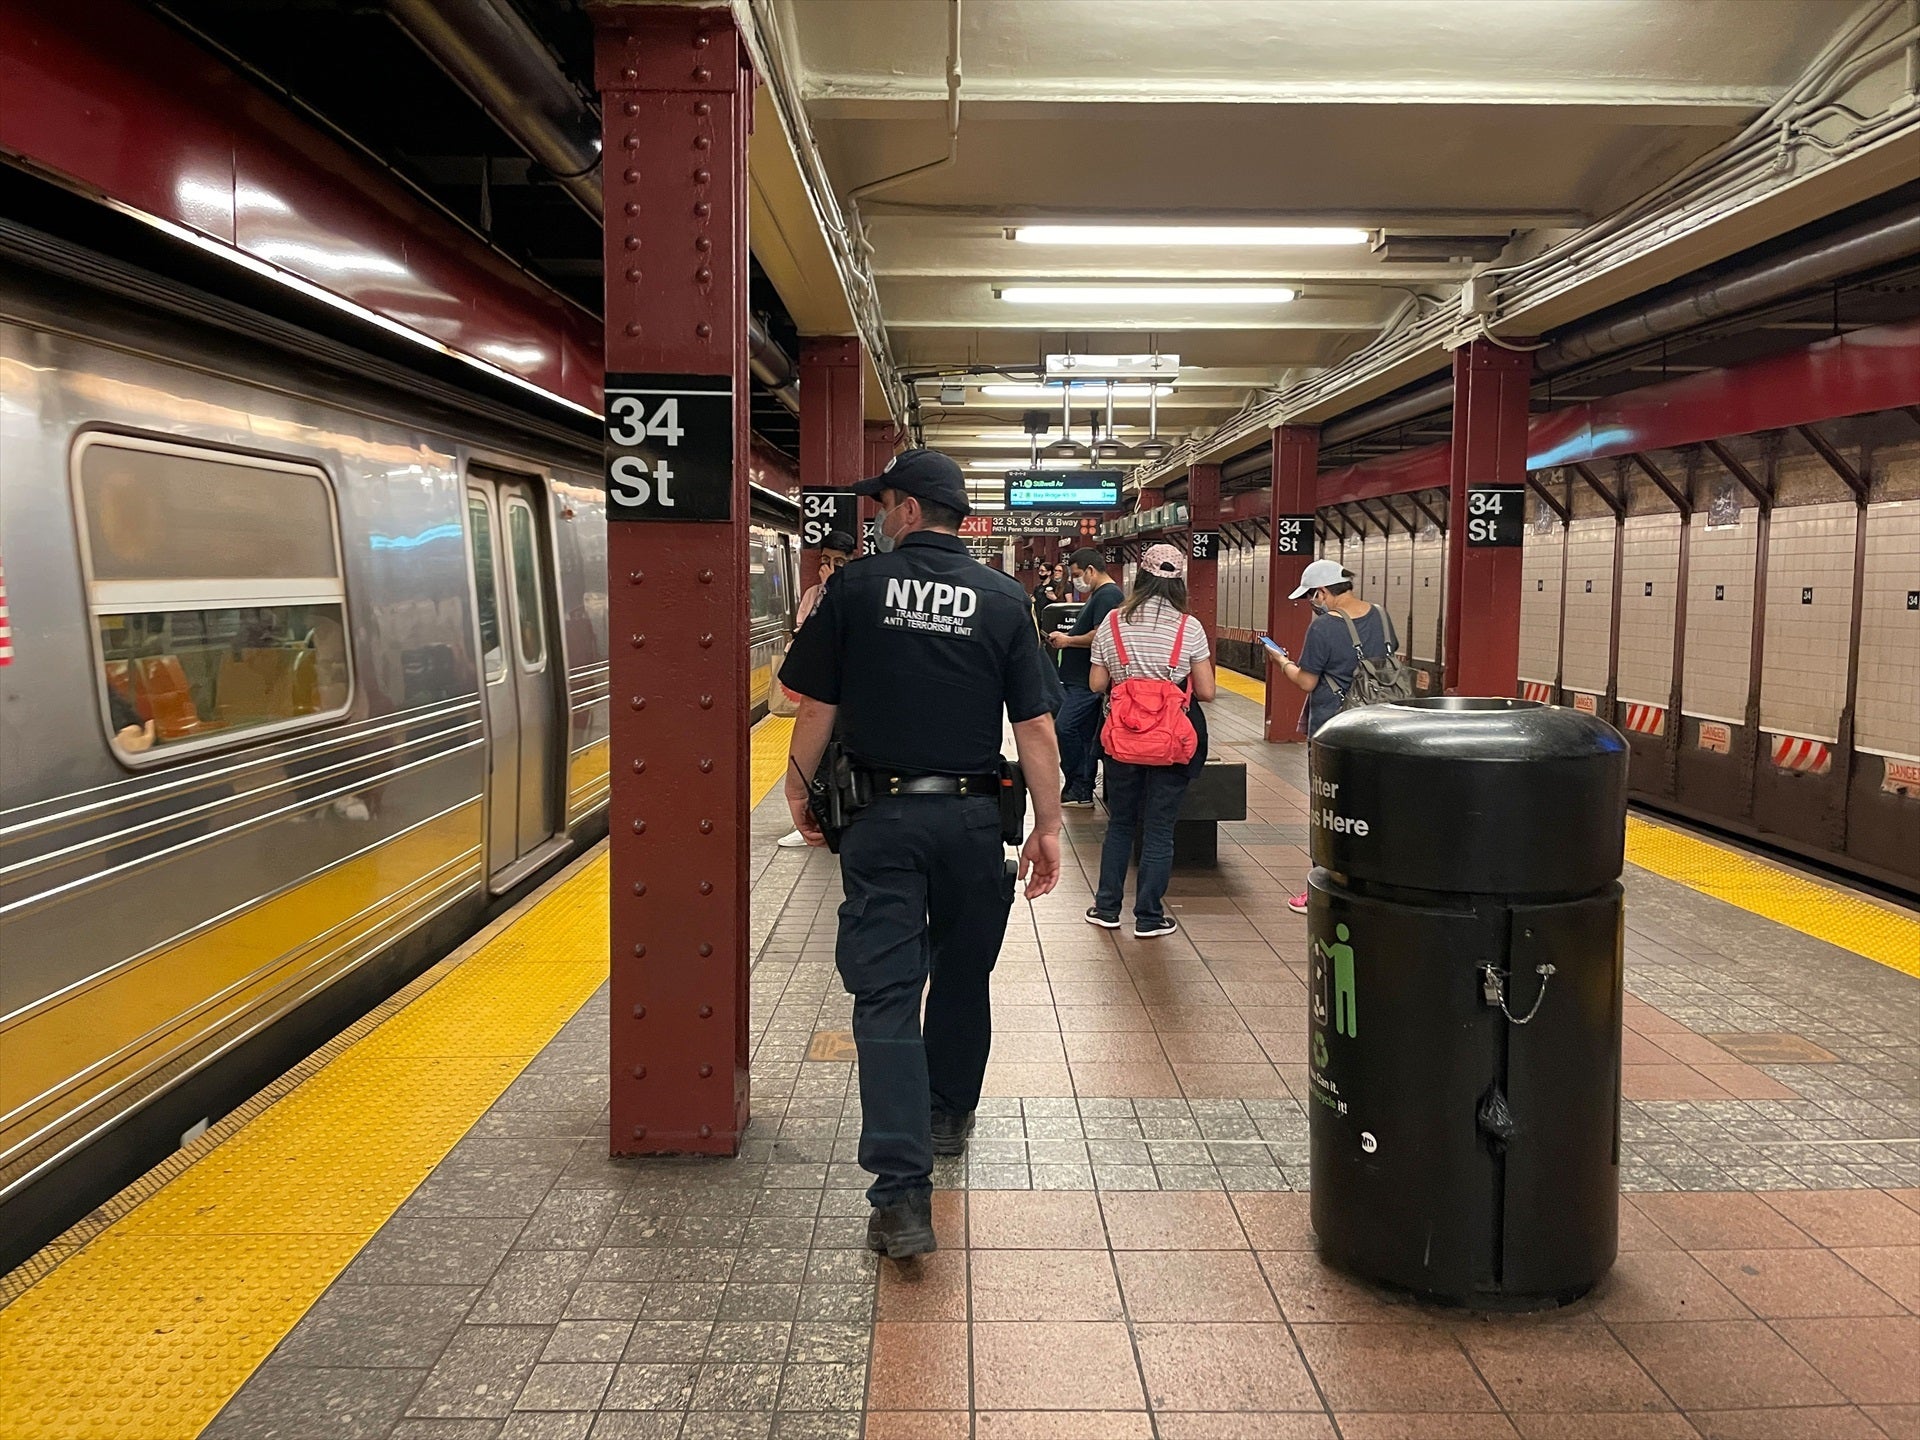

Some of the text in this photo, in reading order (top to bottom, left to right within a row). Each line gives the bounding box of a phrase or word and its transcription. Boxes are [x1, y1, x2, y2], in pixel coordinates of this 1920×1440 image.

[609, 396, 684, 447] 34
[610, 456, 675, 507] St
[804, 496, 837, 518] 34
[1470, 493, 1503, 515] 34
[1006, 518, 1017, 526] St,
[1056, 518, 1078, 527] Bway
[1280, 521, 1301, 535] 34
[1469, 519, 1498, 541] St
[804, 521, 832, 544] St
[1193, 534, 1209, 545] 34
[1193, 546, 1207, 557] St
[1279, 537, 1298, 552] St
[885, 578, 977, 618] NYPD
[1803, 590, 1811, 600] 34
[1908, 595, 1918, 605] 34
[883, 617, 973, 636] ANTI TERRORISM UNIT
[896, 609, 964, 626] TRANSIT BUREAU
[1702, 725, 1726, 739] DANGER
[1888, 763, 1920, 780] DANGE
[1312, 773, 1339, 799] itter
[1322, 808, 1369, 836] Here
